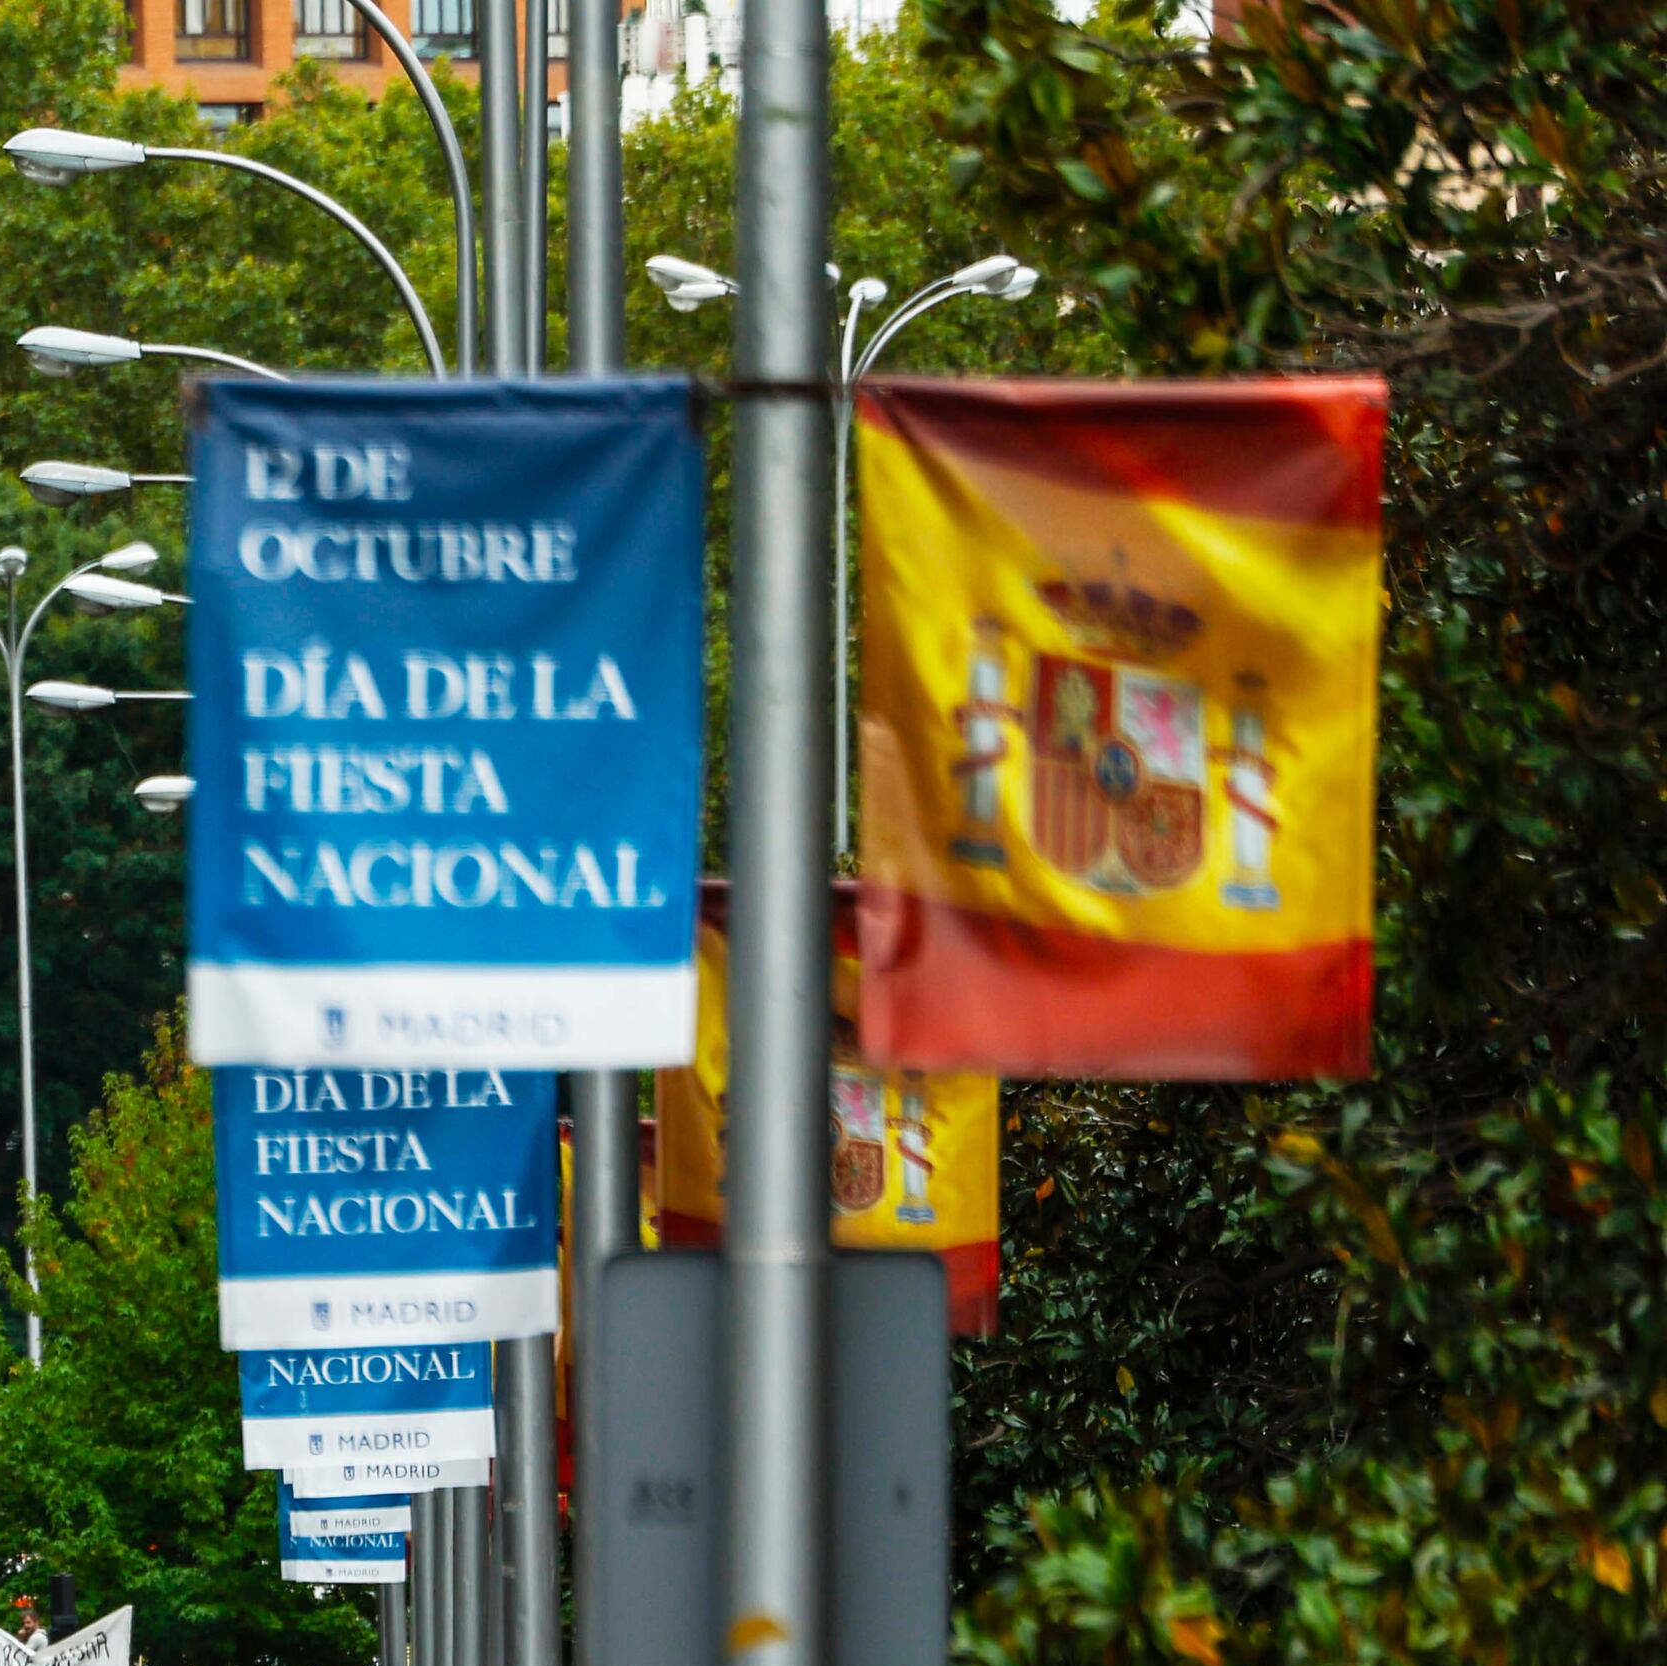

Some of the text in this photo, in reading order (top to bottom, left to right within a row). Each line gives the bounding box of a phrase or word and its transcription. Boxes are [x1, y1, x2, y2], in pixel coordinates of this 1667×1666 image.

[242, 441, 413, 501] 12 DE
[237, 519, 578, 584] OCTUBRE
[242, 634, 638, 721] DÍA DE LA
[241, 742, 509, 814] FIESTA
[242, 838, 667, 908] NACIONAL
[375, 1005, 570, 1051] MADRID
[361, 1069, 433, 1111] DE
[444, 1065, 514, 1108] LA
[253, 1129, 433, 1176] FIESTA
[257, 1186, 537, 1238] NACIONAL
[350, 1300, 478, 1327] MADRID
[267, 1350, 476, 1388] NACIONAL
[338, 1431, 431, 1452] MADRID
[366, 1464, 441, 1480] MADRID
[309, 1533, 400, 1549] NACIONAL
[334, 1517, 381, 1530] MADRID
[338, 1567, 380, 1578] MADRID
